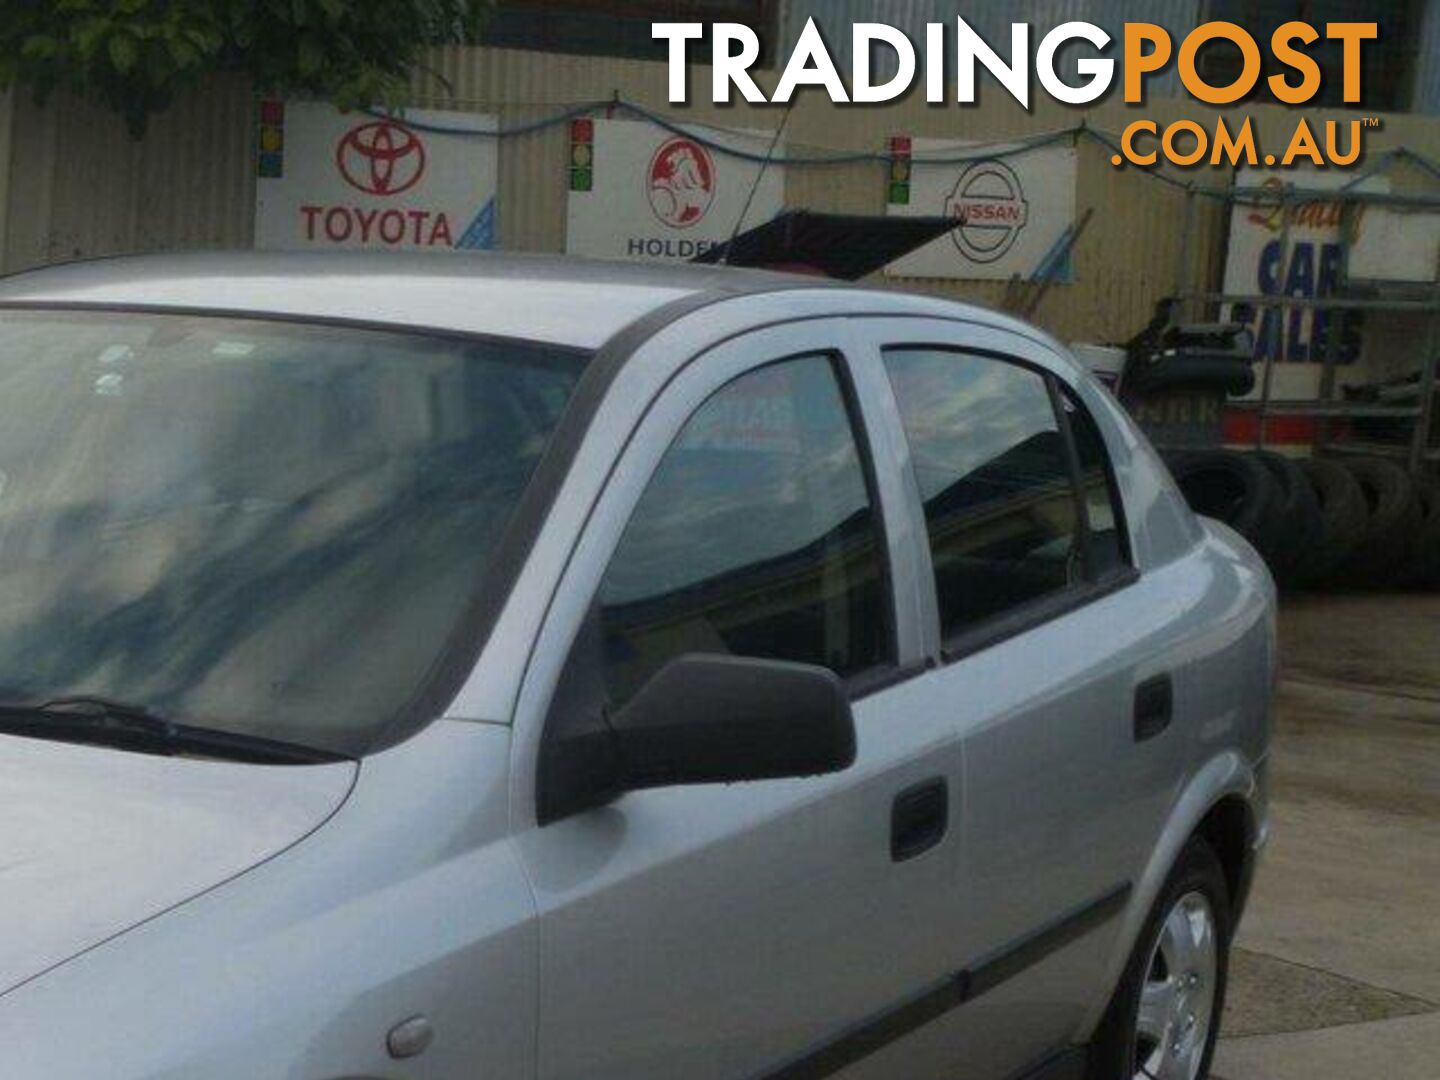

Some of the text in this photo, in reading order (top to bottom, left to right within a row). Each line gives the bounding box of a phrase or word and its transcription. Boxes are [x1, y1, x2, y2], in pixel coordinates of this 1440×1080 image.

[300, 206, 453, 246] TOYOTA
[954, 203, 1020, 221] NISSAN
[1258, 240, 1348, 296] CAR
